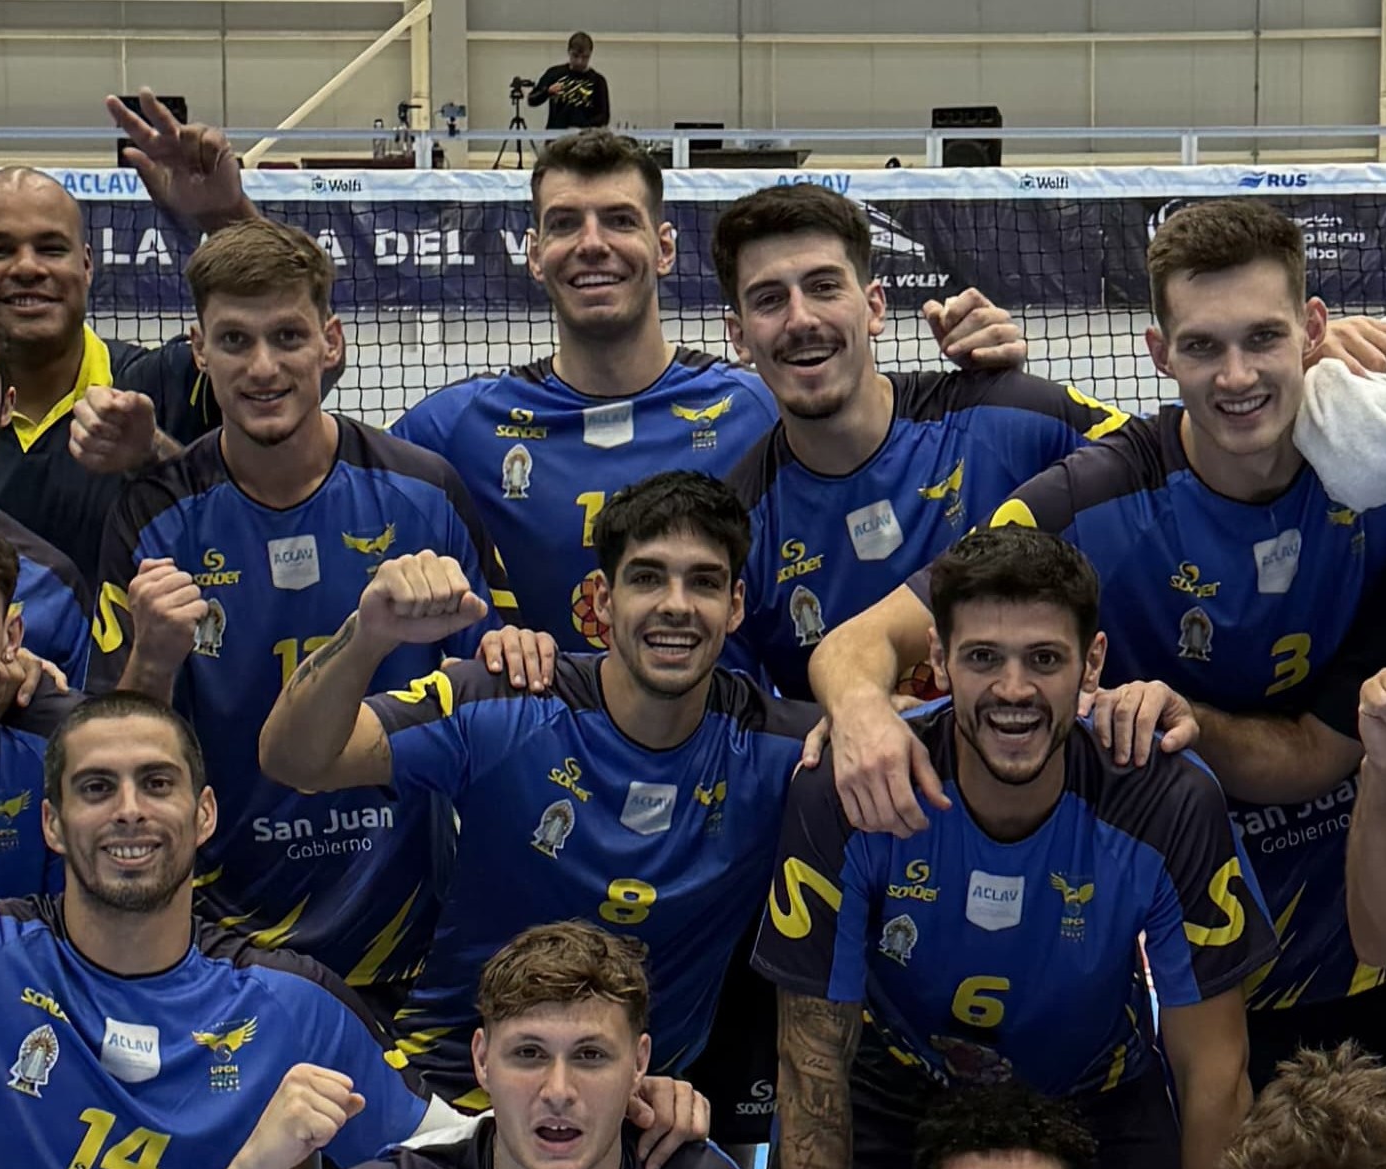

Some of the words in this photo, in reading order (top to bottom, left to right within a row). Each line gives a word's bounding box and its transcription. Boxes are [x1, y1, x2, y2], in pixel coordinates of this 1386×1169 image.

[63, 172, 139, 195] ACLAV
[328, 178, 363, 193] Wolfi
[1037, 176, 1070, 190] Wolfi
[1266, 172, 1308, 188] RUS
[101, 227, 173, 266] LA
[372, 227, 476, 266] DEL
[895, 273, 950, 288] VOLEY
[1265, 632, 1313, 696] 3
[251, 817, 313, 844] San
[322, 805, 394, 835] Juan
[1260, 813, 1352, 854] Gobierno
[285, 835, 373, 861] Gobierno
[598, 877, 658, 925] 8
[971, 884, 1020, 903] ACLAV
[951, 975, 1011, 1029] 6
[108, 1031, 154, 1054] ACLAV
